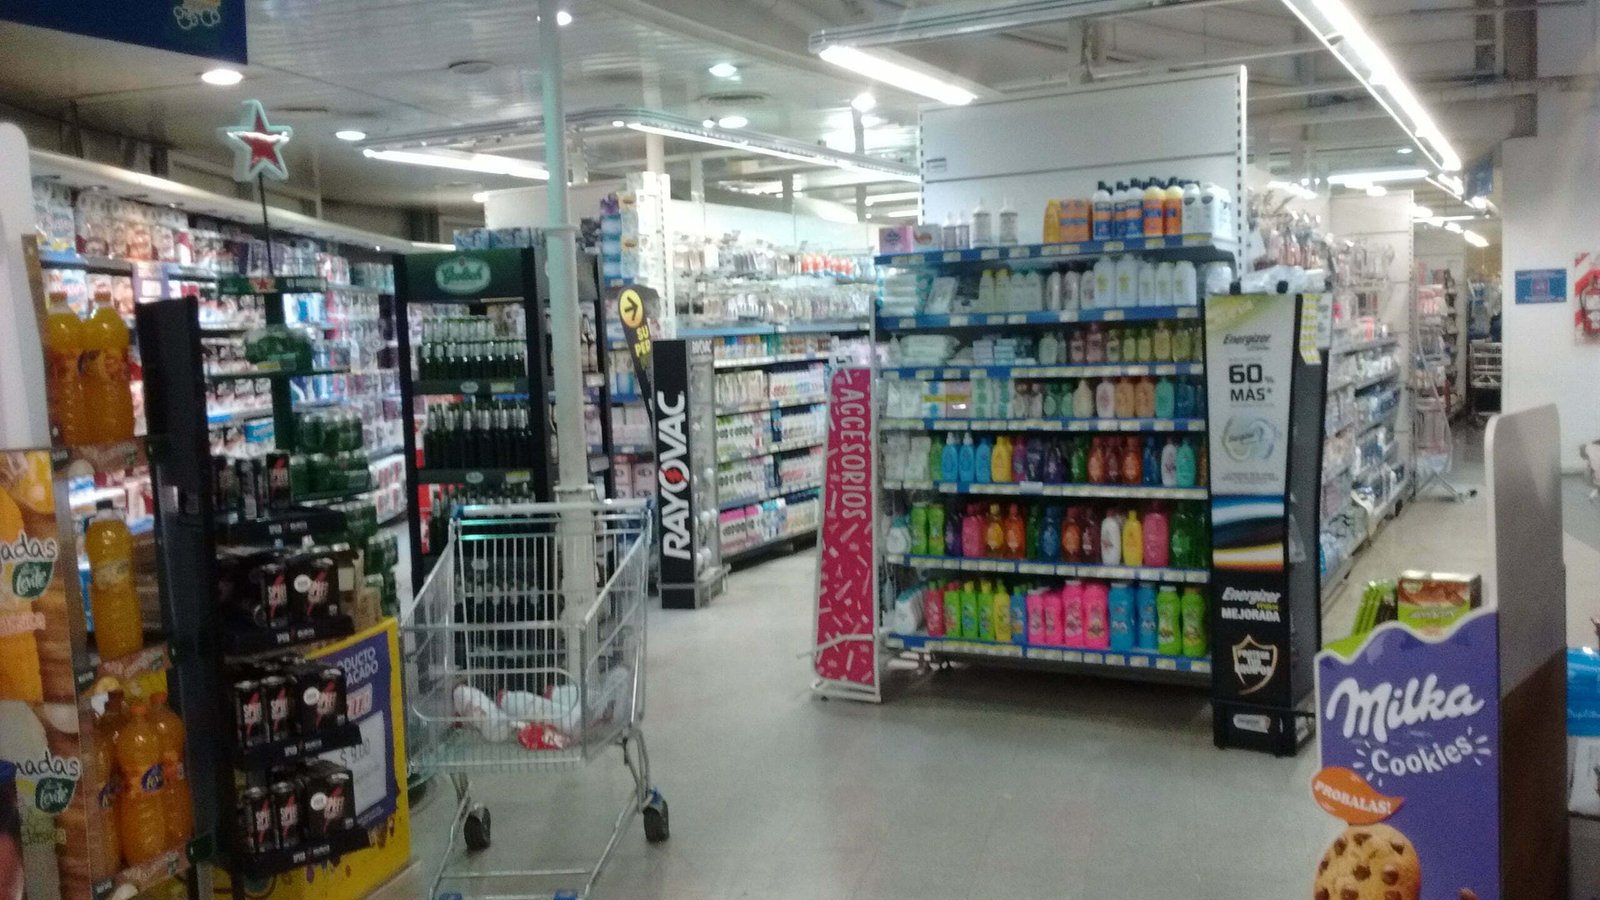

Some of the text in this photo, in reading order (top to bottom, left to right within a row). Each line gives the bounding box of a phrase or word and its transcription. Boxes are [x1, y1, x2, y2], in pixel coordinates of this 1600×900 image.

[1223, 332, 1272, 346] Energizer
[838, 387, 867, 519] ACCESORIOS
[656, 389, 692, 561] RAYOVAC
[0, 533, 56, 562] adas
[1221, 586, 1282, 605] Energizer
[1221, 607, 1281, 622] MEJORADA
[1325, 673, 1487, 743] Milka
[1371, 734, 1474, 777] Cookies
[1314, 780, 1393, 815] PROBALAS!
